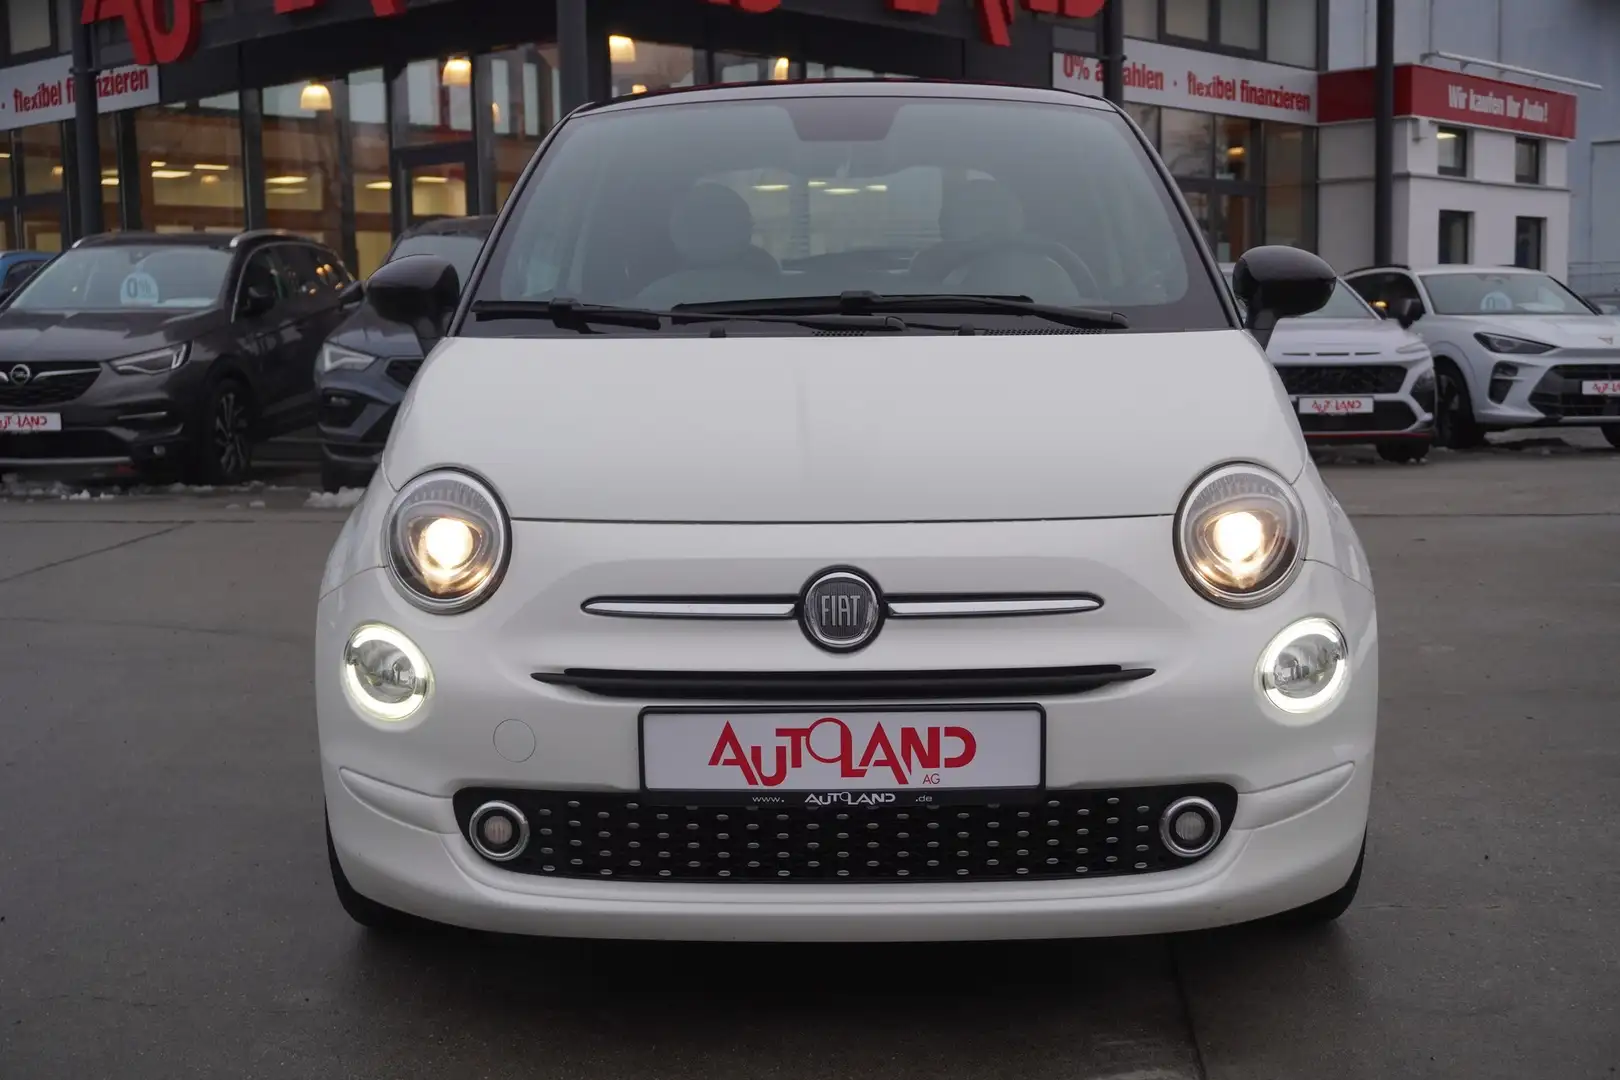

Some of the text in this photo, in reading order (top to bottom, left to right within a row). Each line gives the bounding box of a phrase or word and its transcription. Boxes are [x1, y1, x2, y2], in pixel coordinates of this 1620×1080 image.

[13, 80, 62, 113] flexibel
[1063, 53, 1310, 112] 0% aahlen flexibel finanzieren
[821, 595, 861, 626] FIAT
[708, 717, 977, 787] AUTOLAND
[922, 773, 941, 785] AG
[804, 792, 896, 806] AUTOLAND
